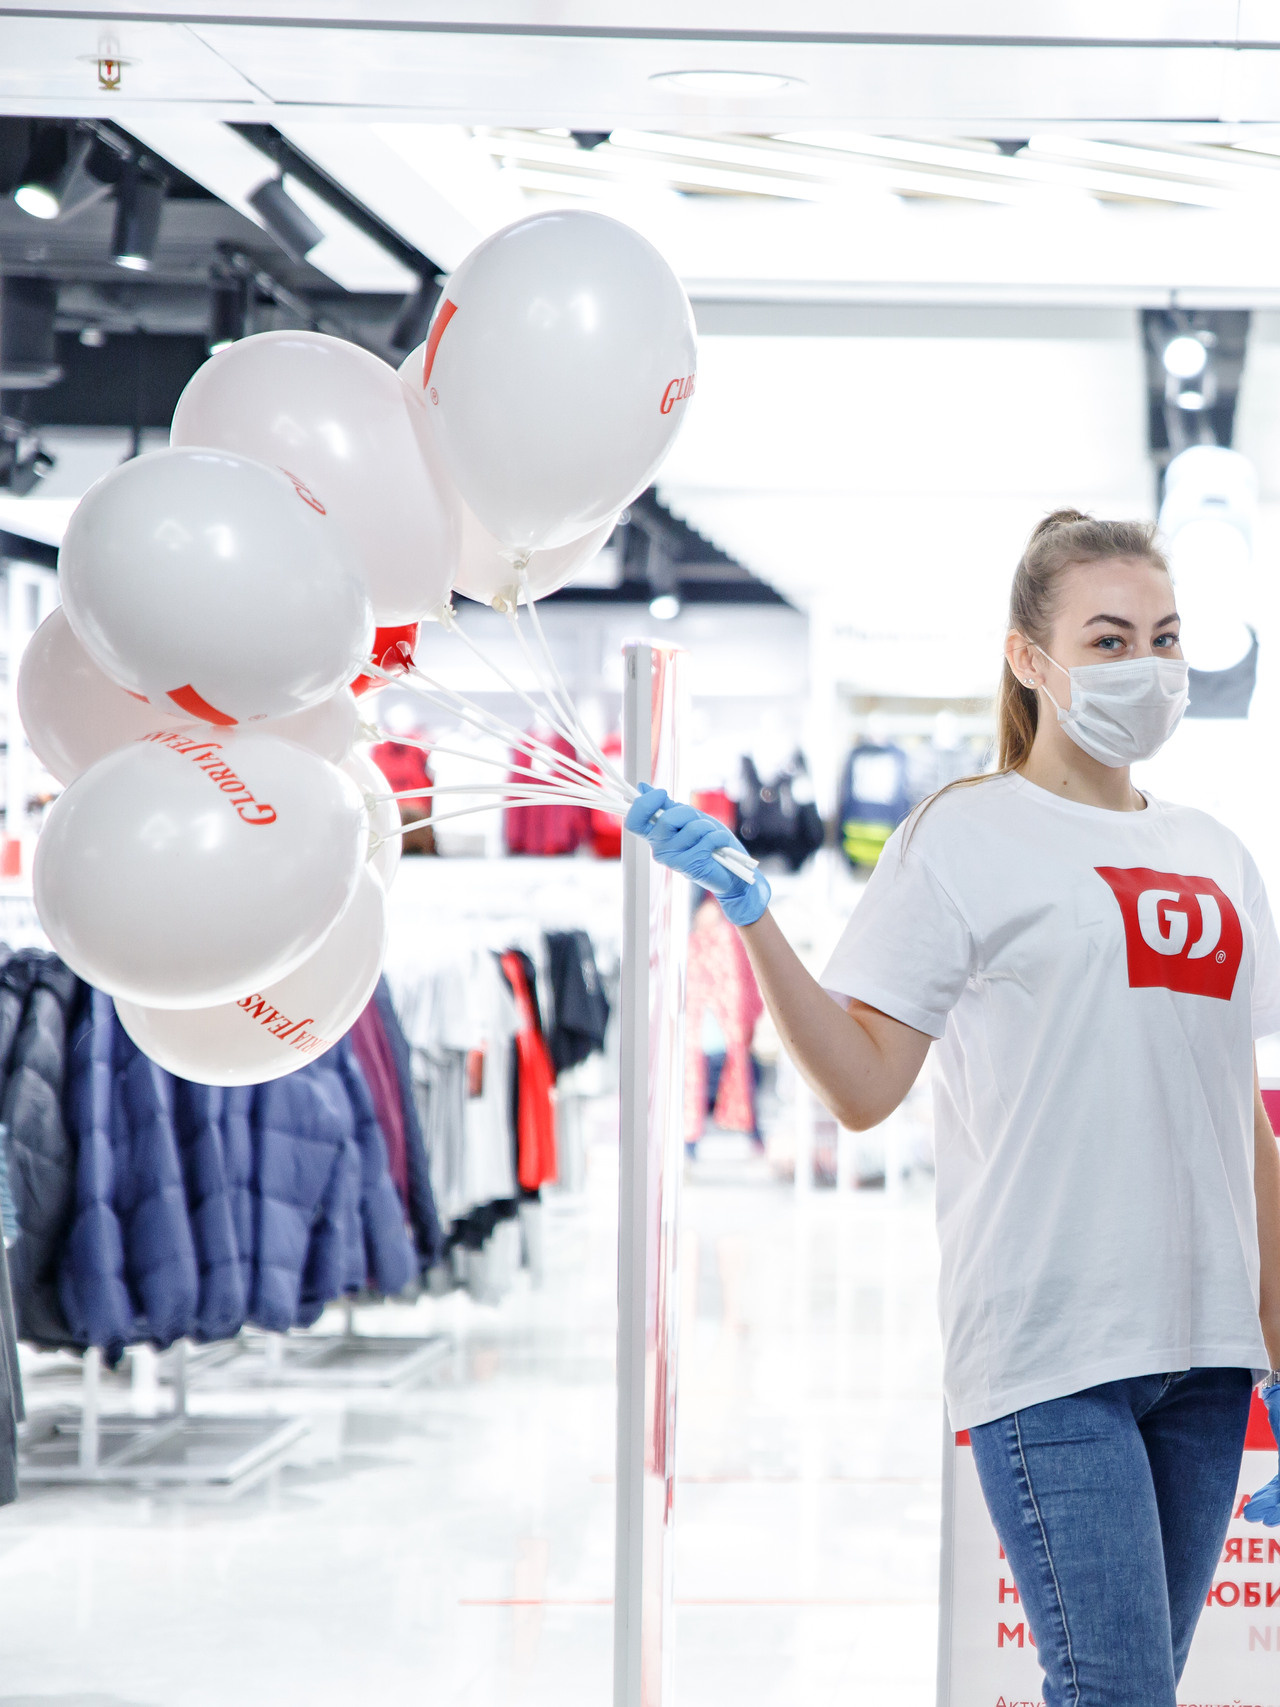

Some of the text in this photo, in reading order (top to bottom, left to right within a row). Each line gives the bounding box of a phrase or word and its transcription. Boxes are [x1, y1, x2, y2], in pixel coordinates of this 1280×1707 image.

[192, 751, 277, 825] GLORIA
[1137, 889, 1222, 960] GJ
[236, 993, 315, 1040] JEANS
